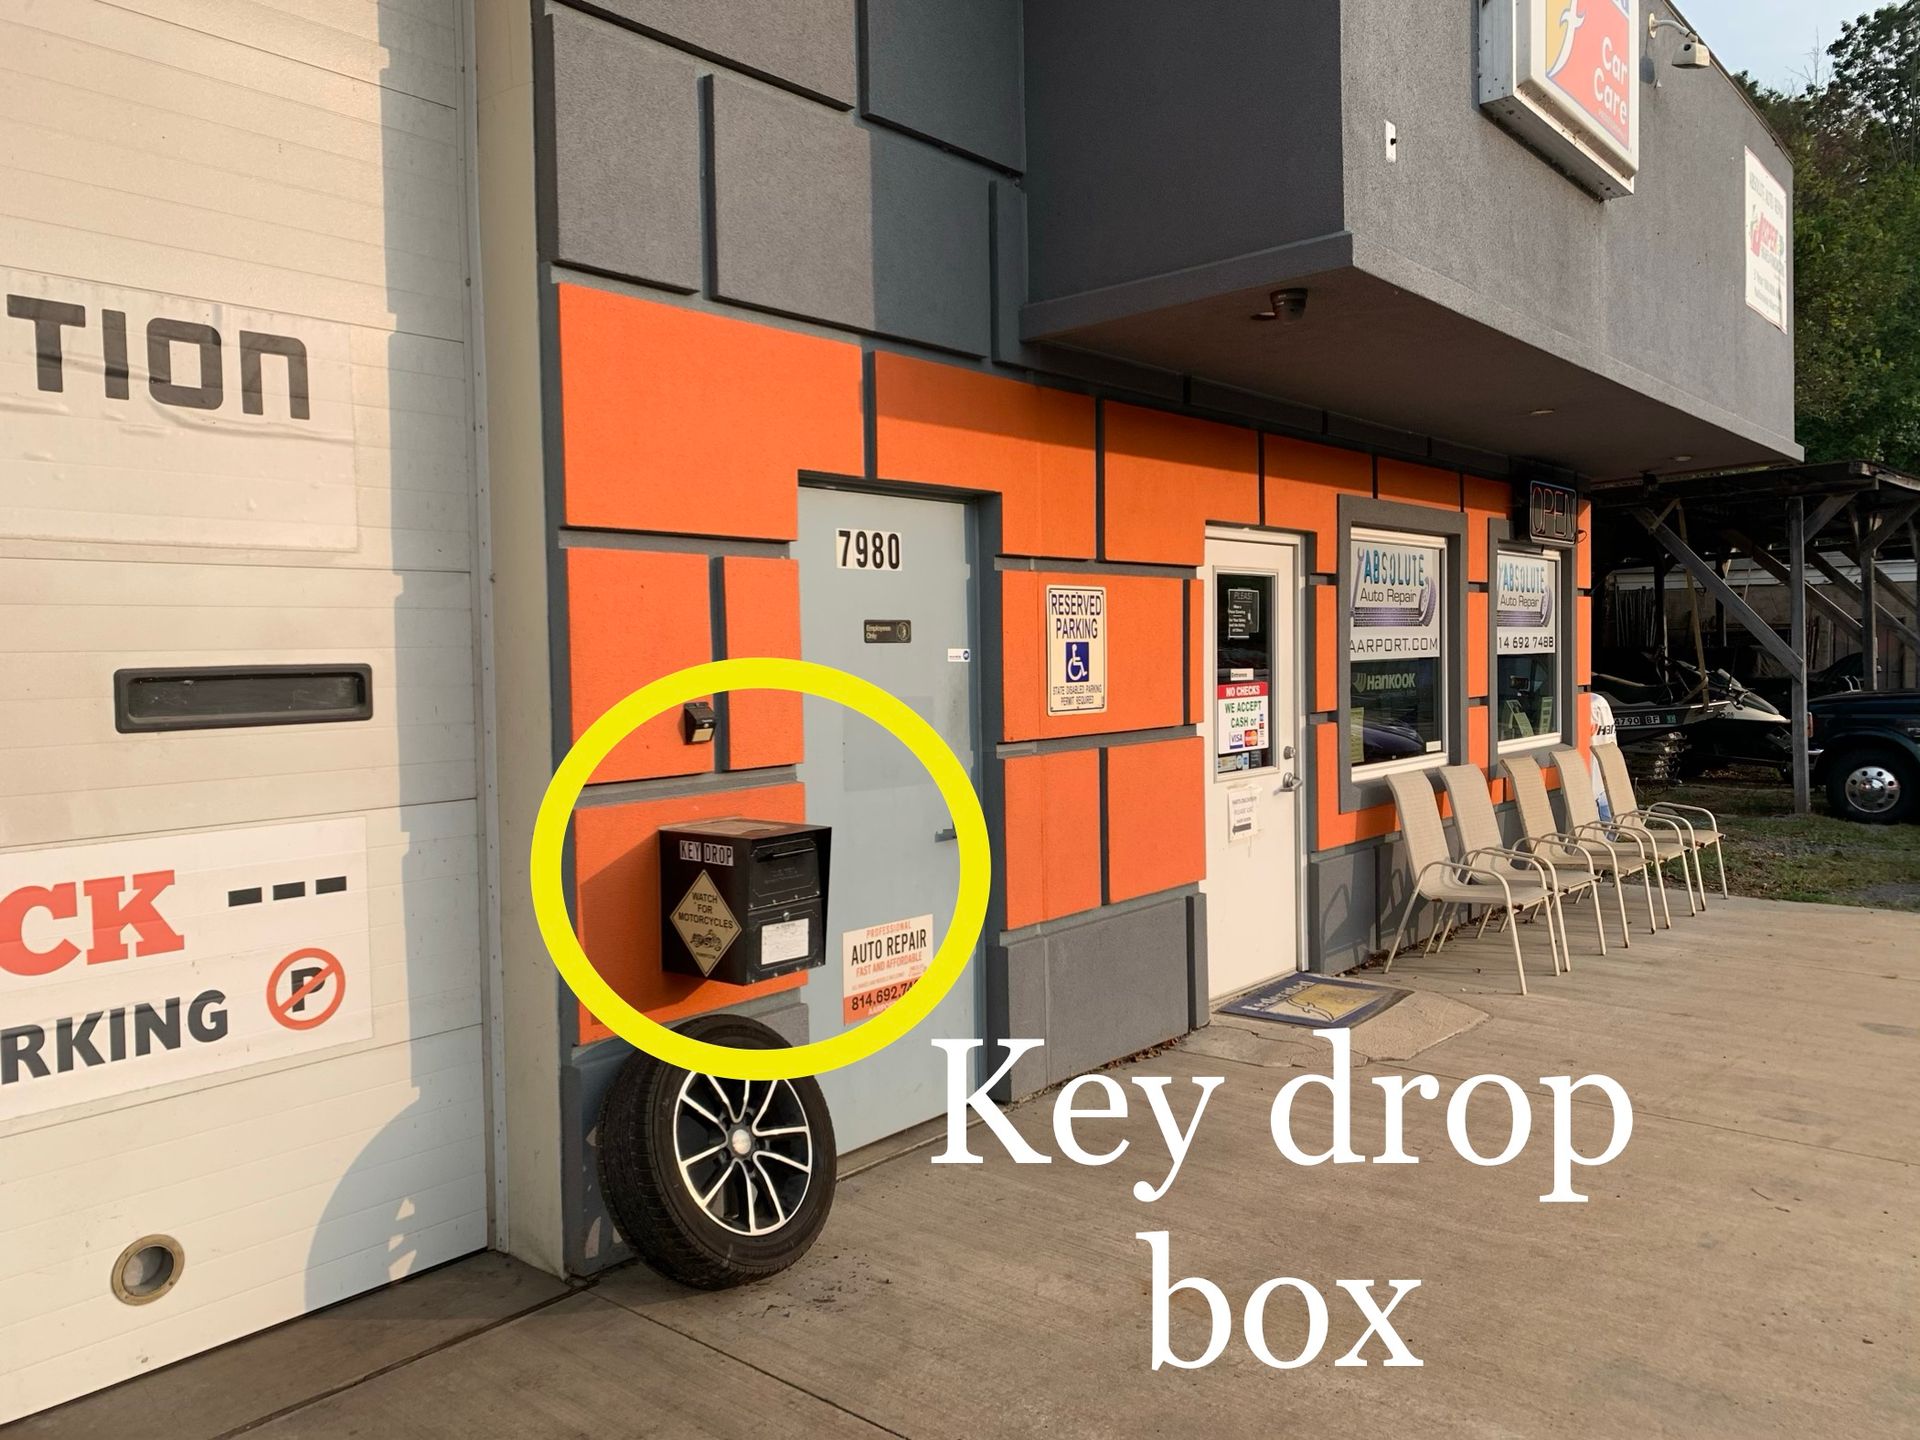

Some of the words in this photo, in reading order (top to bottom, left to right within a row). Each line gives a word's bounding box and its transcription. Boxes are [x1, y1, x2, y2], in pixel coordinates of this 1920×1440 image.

[1602, 36, 1628, 85] Car
[1593, 67, 1628, 126] Care
[1533, 486, 1575, 541] OPEN
[838, 530, 900, 570] 7980
[1364, 549, 1424, 588] ABSOLUTE
[1502, 563, 1546, 594] ABSOLUTE
[1051, 594, 1102, 616] RESERVED
[1360, 587, 1384, 603] Auto
[1387, 588, 1417, 606] Repair
[1501, 594, 1517, 607] Auto
[1519, 595, 1540, 609] Repair
[1056, 618, 1098, 639] PARKING
[1513, 636, 1530, 649] 692
[1053, 685, 1065, 696] STATE
[1086, 684, 1102, 693] PARKING
[1226, 686, 1235, 697] NO
[1236, 684, 1260, 696] CHECKS
[1225, 702, 1235, 714] WE
[1237, 700, 1262, 713] ACCEPT
[1231, 716, 1249, 729] CASH
[1250, 718, 1257, 726] or
[1232, 733, 1242, 743] VISA
[681, 840, 701, 861] KEY
[704, 843, 733, 865] DROP
[692, 892, 718, 904] WATCH
[697, 904, 713, 914] FOR
[678, 912, 733, 929] MOTORCYCLES
[866, 921, 912, 939] PROFESSIONAL
[851, 939, 883, 966] AUTO
[886, 929, 927, 957] REPAIR
[856, 965, 872, 978] FAST
[872, 960, 885, 973] AND
[886, 952, 923, 969] AFFORDABLE
